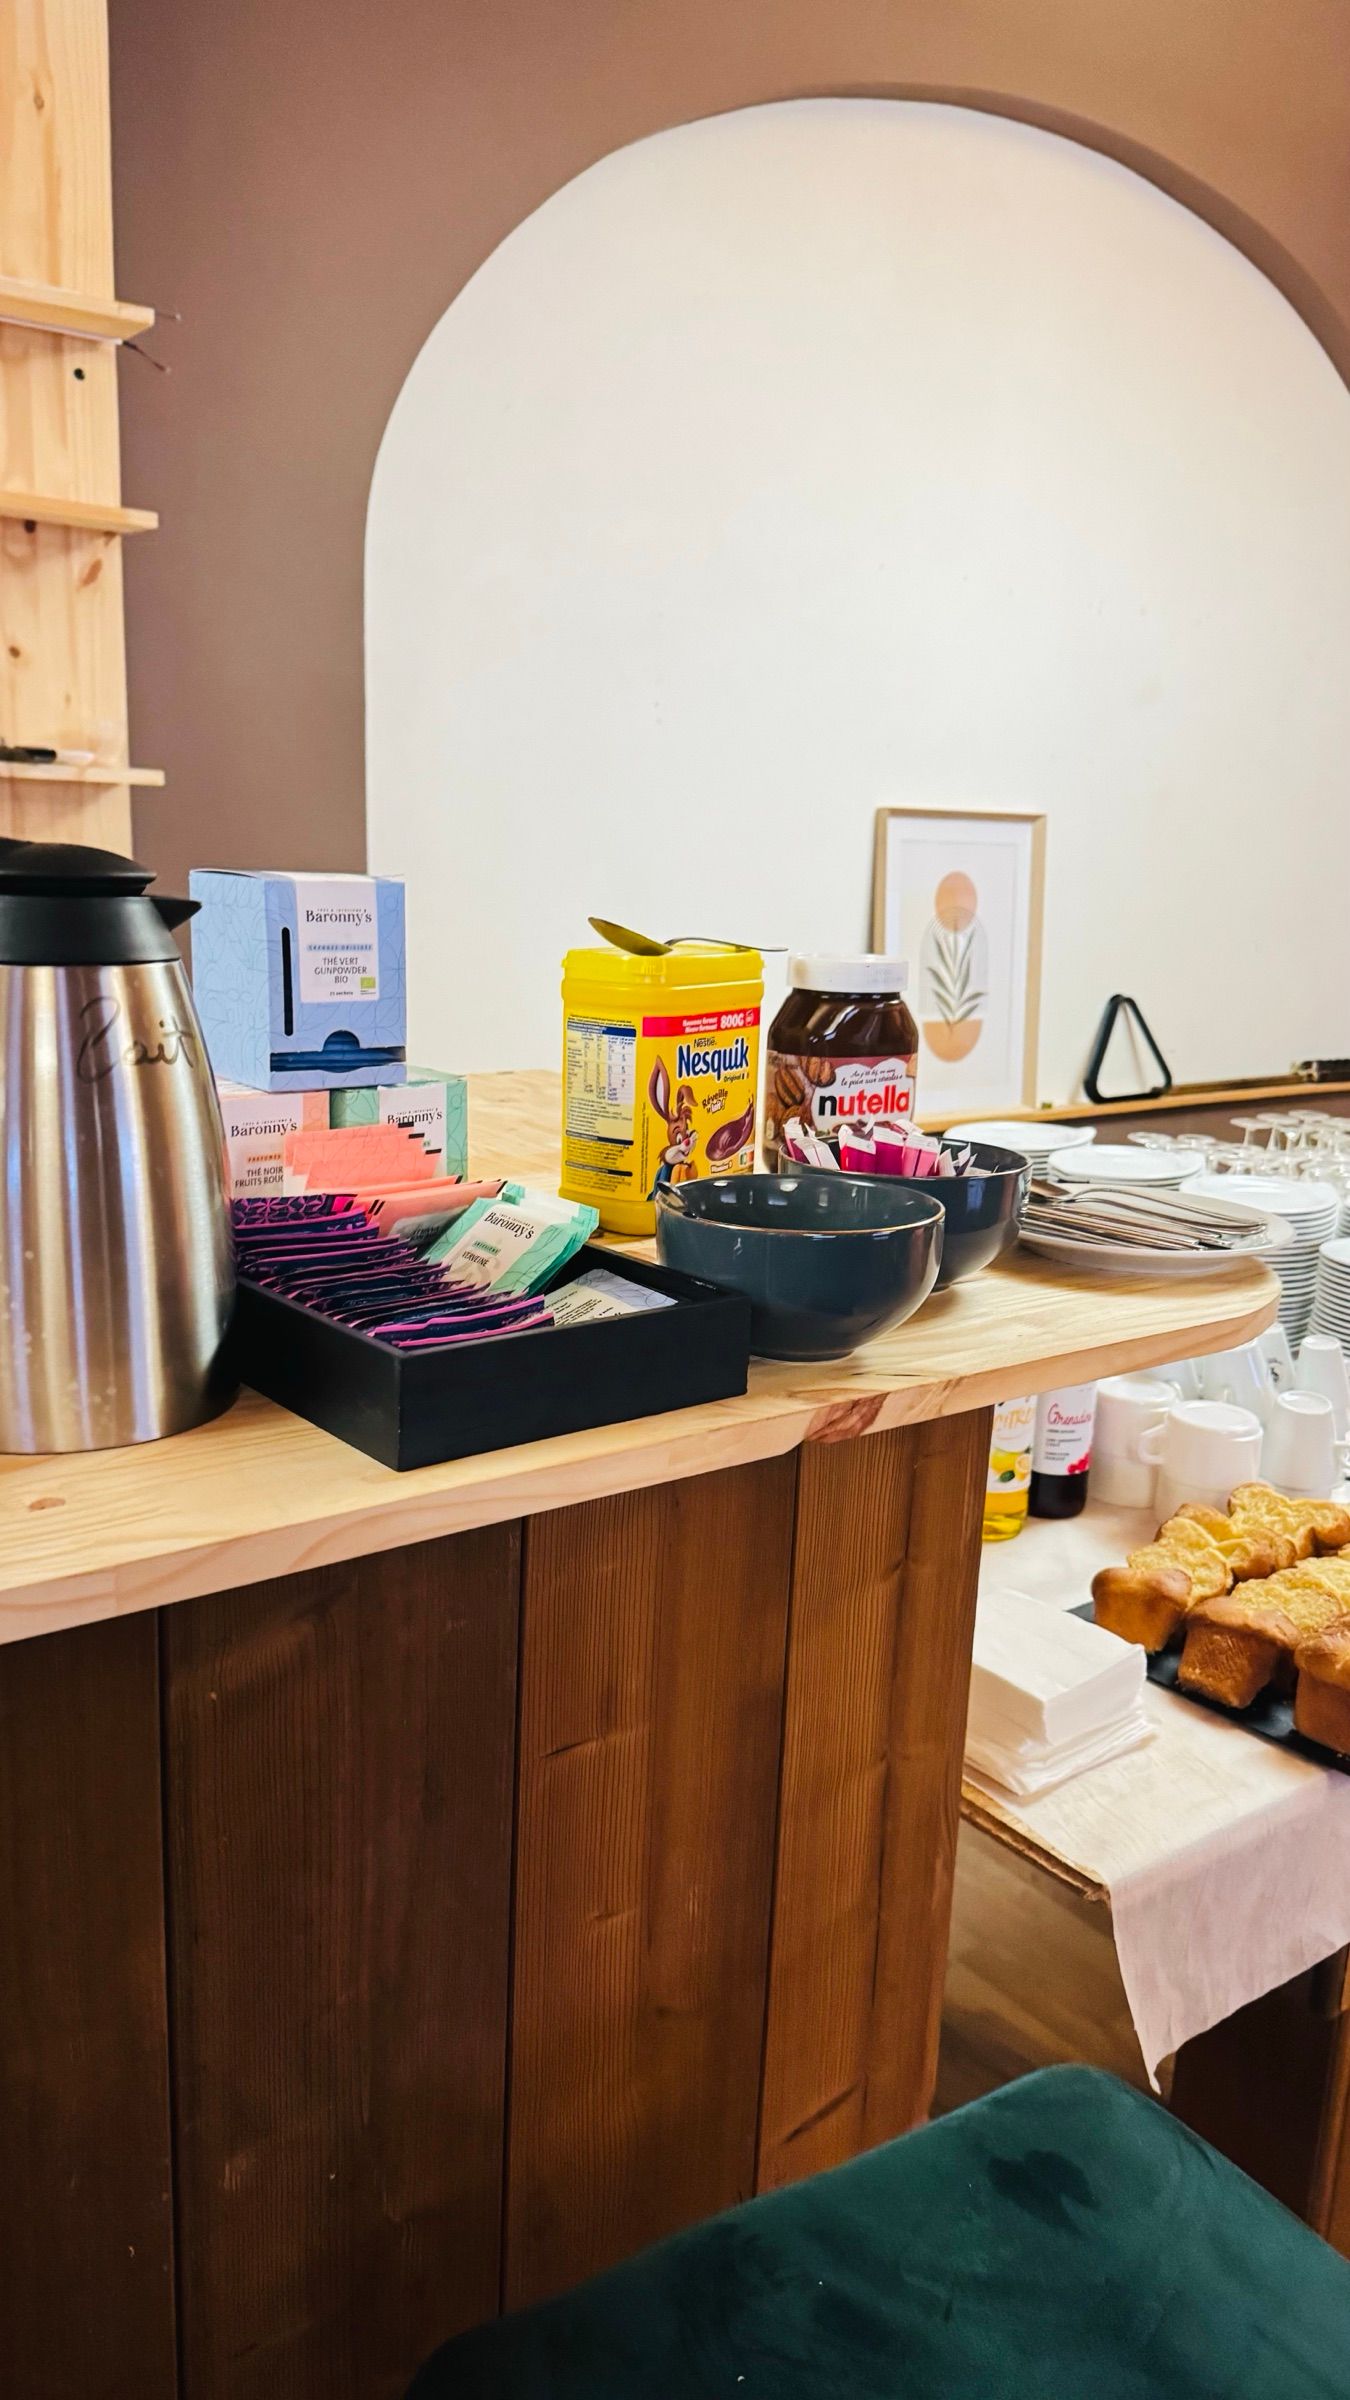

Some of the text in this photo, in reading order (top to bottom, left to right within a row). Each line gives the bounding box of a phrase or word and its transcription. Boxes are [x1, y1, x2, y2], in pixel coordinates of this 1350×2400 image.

[305, 908, 373, 927] Baronny's
[323, 956, 358, 966] THÉ VERT
[314, 966, 367, 975] GUNPOWDER
[334, 975, 349, 984] BIO
[677, 1038, 749, 1081] Nesquik
[818, 1084, 910, 1117] nutella
[388, 1107, 443, 1125] Baronny's
[230, 1117, 298, 1138] Baronny's
[247, 1167, 262, 1178] THÉ
[235, 1177, 262, 1188] FRUITS
[484, 1211, 535, 1240] Baronny's
